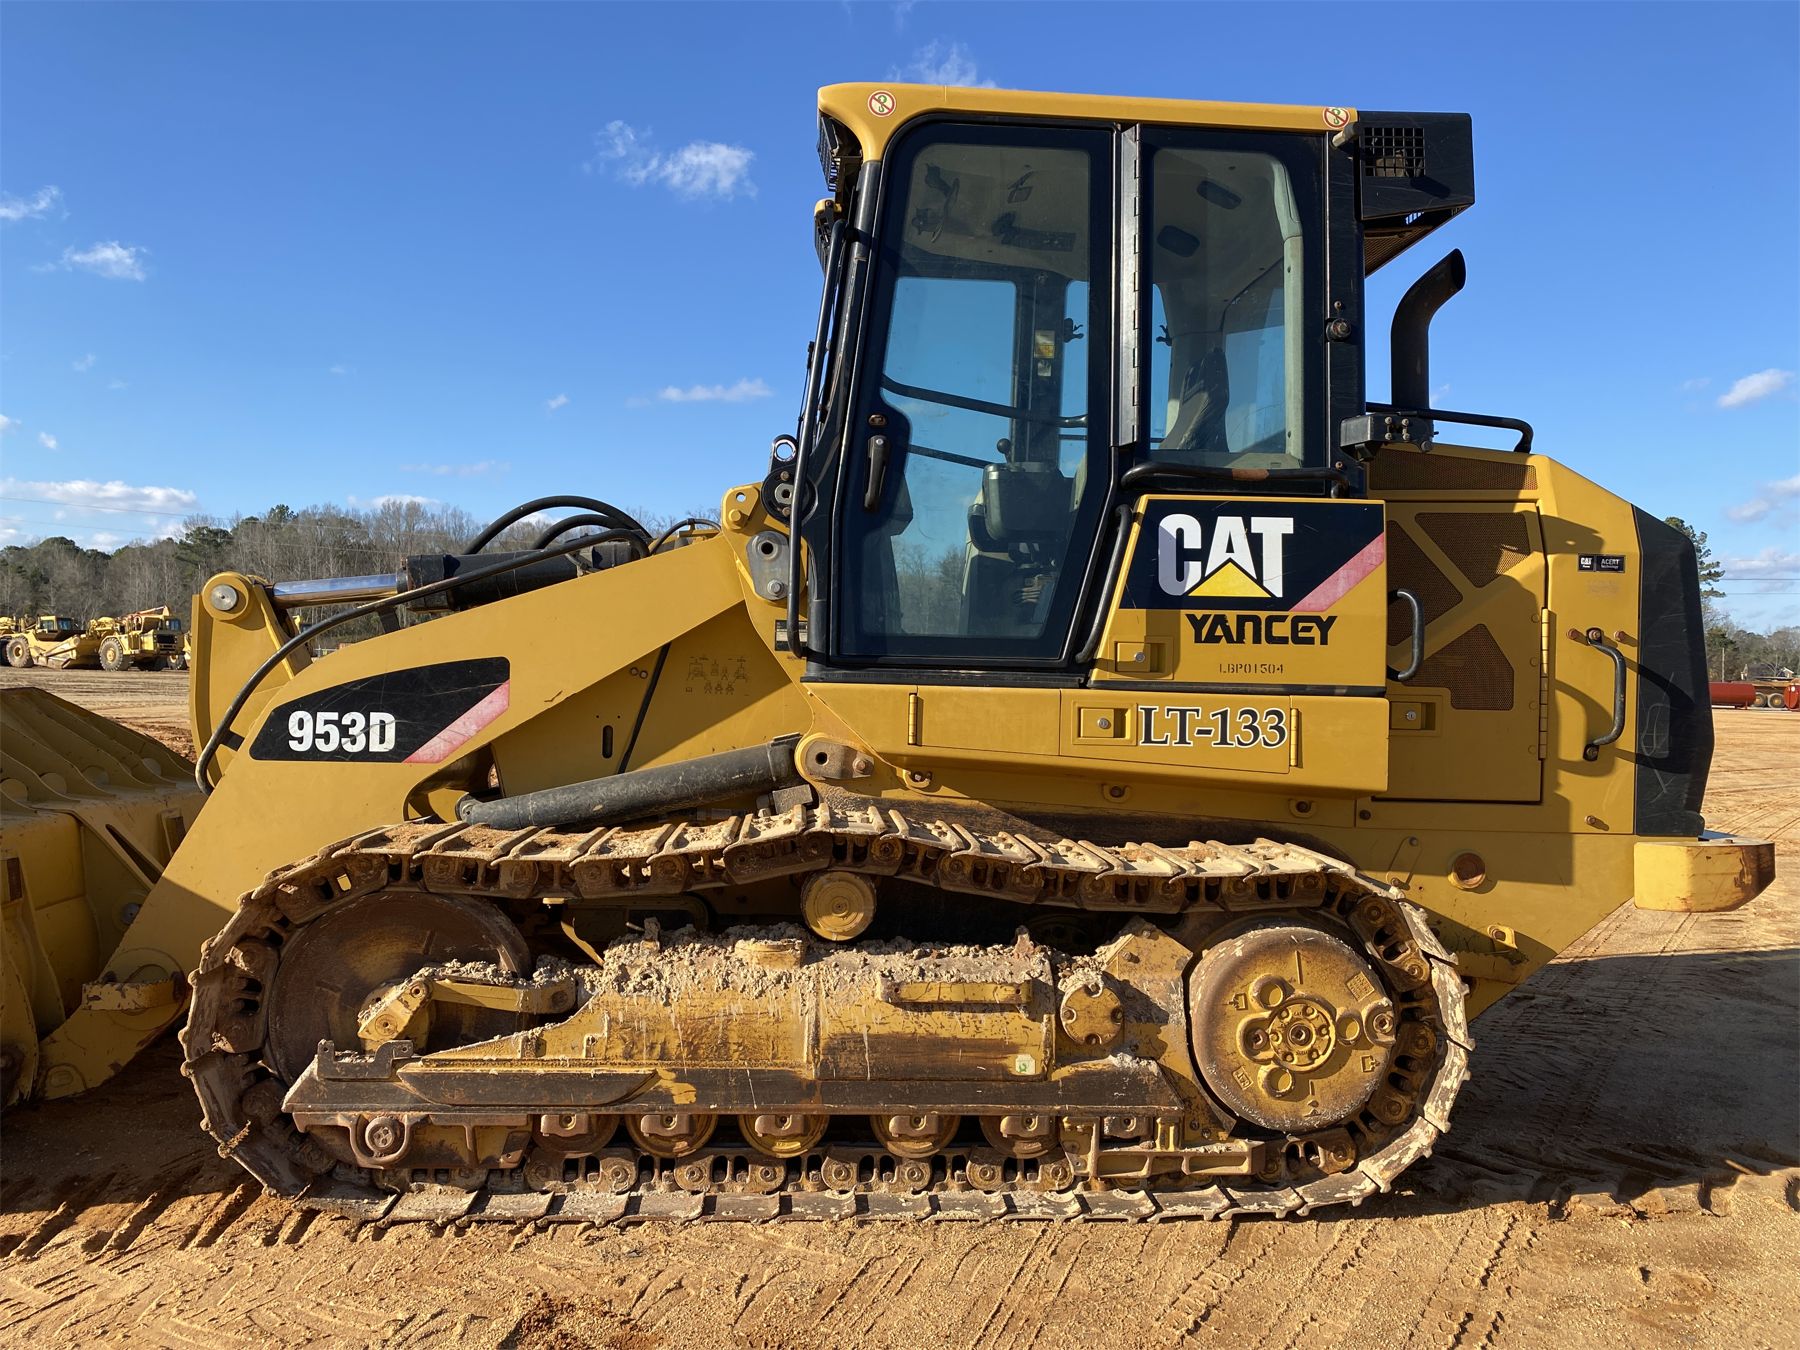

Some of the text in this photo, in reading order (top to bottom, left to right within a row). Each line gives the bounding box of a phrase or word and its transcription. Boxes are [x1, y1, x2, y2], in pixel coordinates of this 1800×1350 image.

[1158, 513, 1294, 598] CAT
[1581, 557, 1592, 565] CAT
[1185, 613, 1338, 646] YANCEY
[1219, 663, 1284, 674] LBP01504
[288, 710, 396, 753] 953D
[1138, 705, 1288, 749] LT-133
